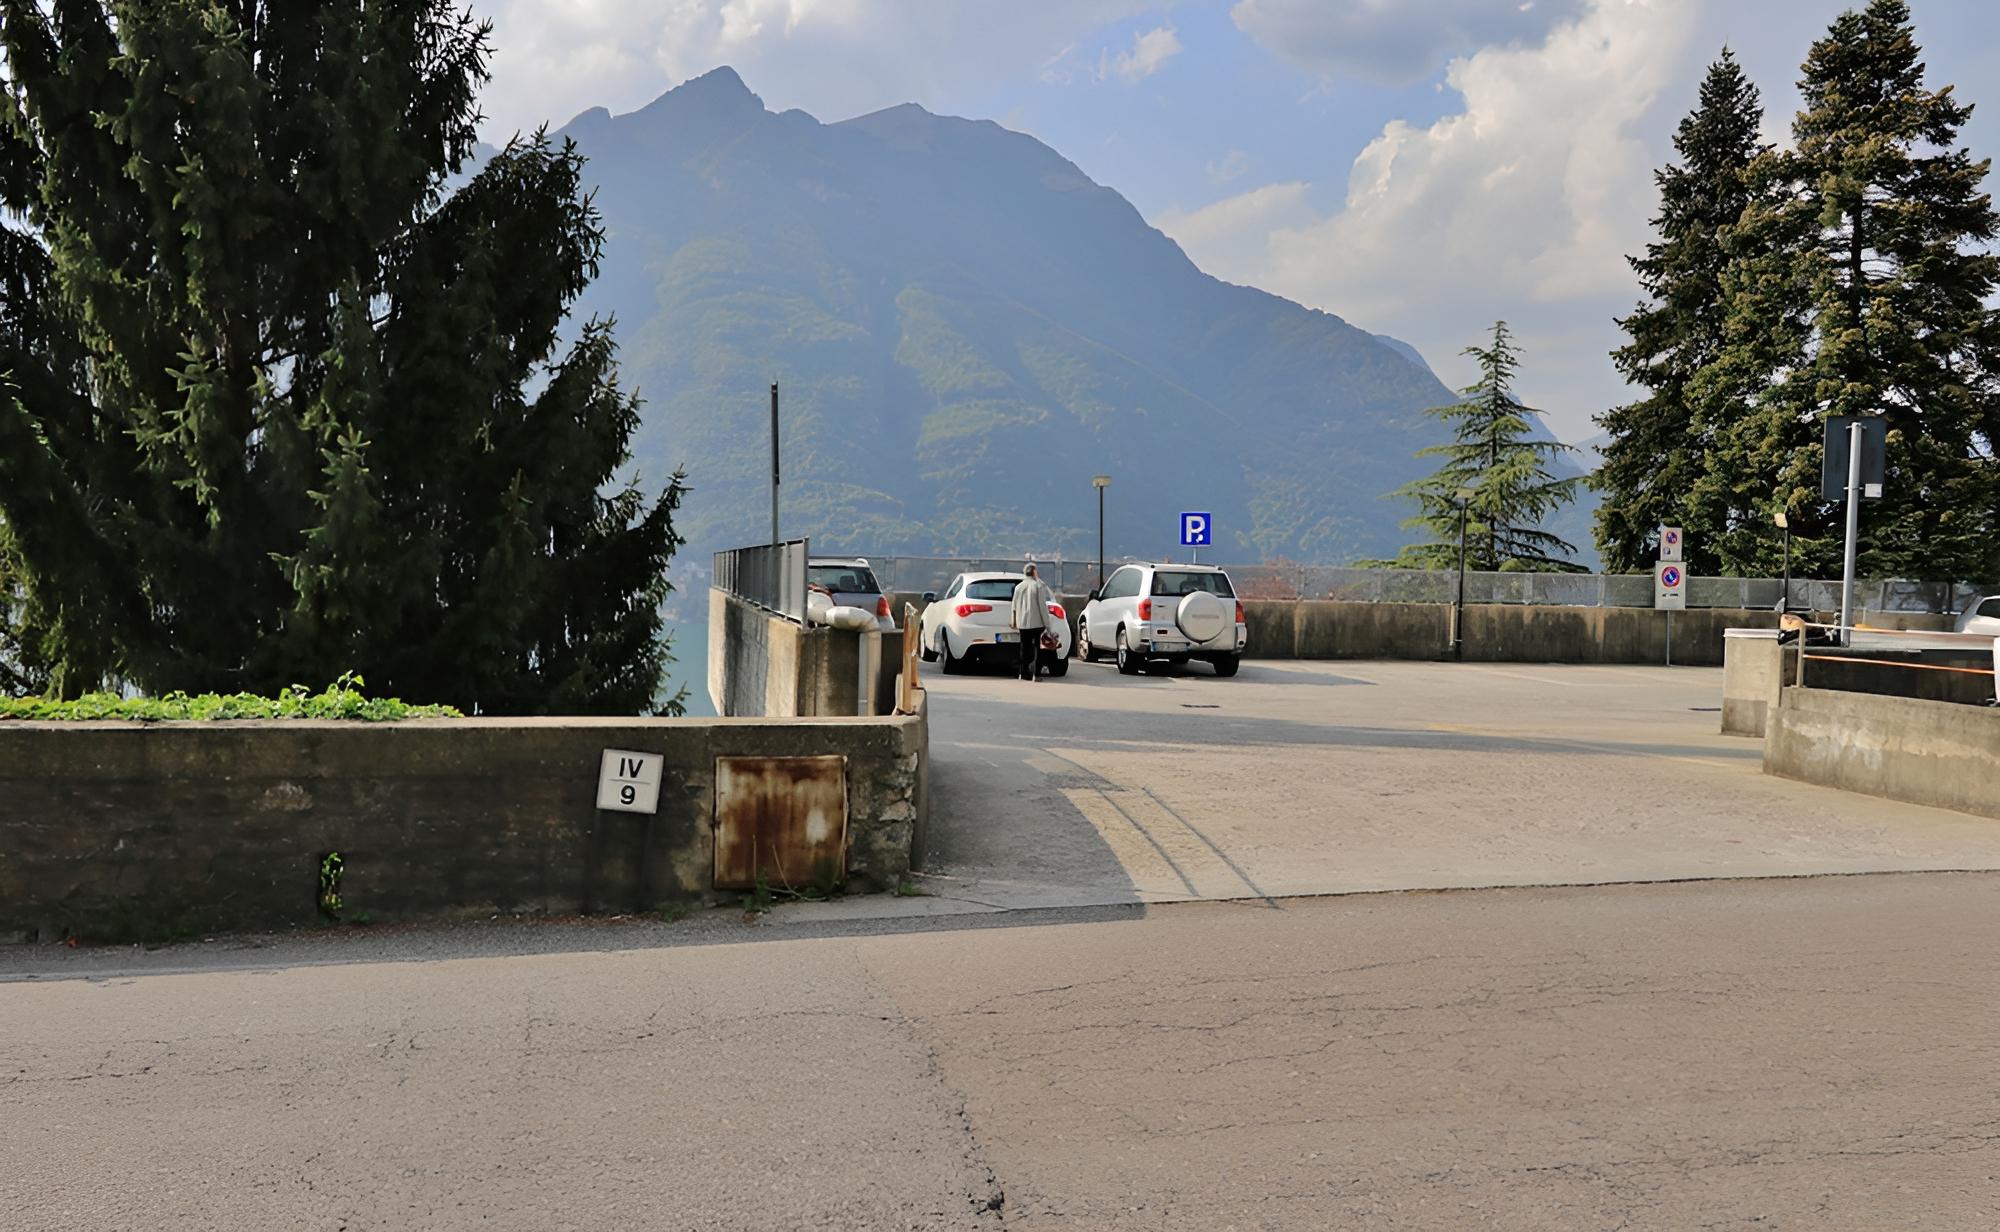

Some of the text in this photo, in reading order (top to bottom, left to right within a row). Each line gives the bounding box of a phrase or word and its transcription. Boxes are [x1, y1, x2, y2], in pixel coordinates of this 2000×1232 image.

[1186, 516, 1205, 543] P
[619, 757, 644, 778] IV
[620, 785, 636, 805] 9
